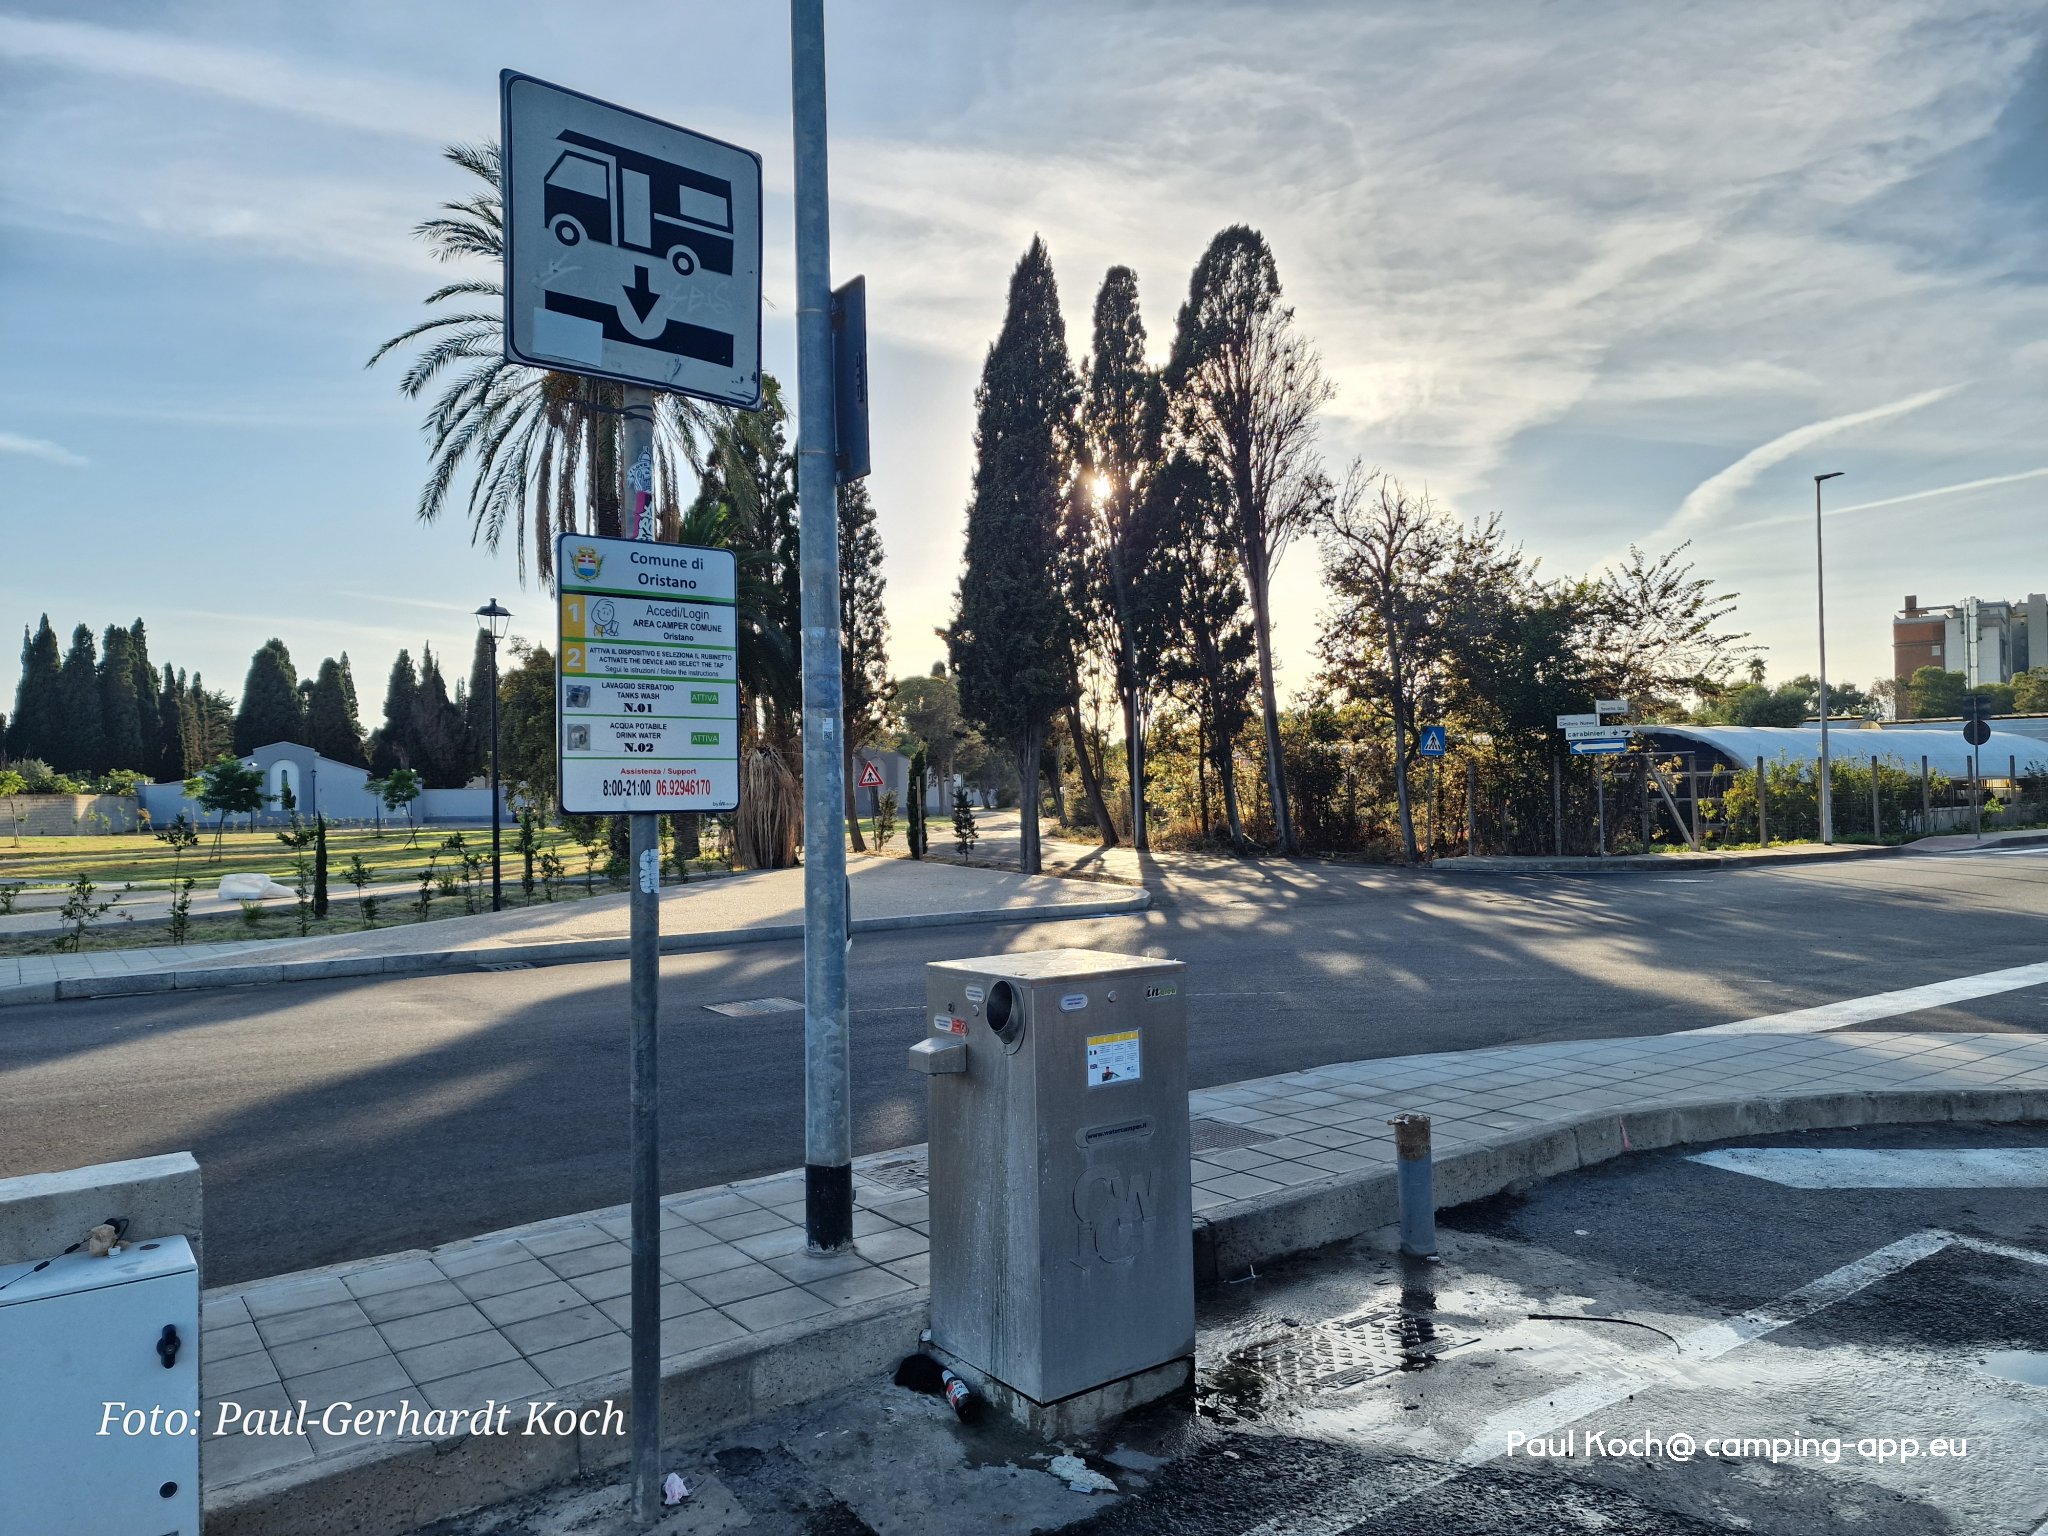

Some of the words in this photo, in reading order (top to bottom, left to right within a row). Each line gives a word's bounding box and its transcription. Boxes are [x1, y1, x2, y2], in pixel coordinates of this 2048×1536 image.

[630, 551, 687, 569] Comune
[692, 557, 704, 570] di
[638, 572, 697, 589] Oristano
[567, 603, 579, 623] 1
[646, 604, 710, 622] Accedi/Login
[633, 619, 655, 628] AREA
[656, 621, 688, 631] CAMPER
[690, 623, 722, 633] COMUNE
[663, 632, 694, 642] Oristano
[566, 647, 581, 668] 2
[589, 647, 611, 655] ATTIVA
[618, 649, 655, 657] DISPOSITIVO
[661, 651, 694, 659] SELEZIONA
[701, 653, 732, 661] RUBINETTO
[599, 656, 628, 664] ACTIVATE
[642, 658, 664, 666] DEVICE
[605, 664, 622, 674] Segui
[623, 665, 629, 673] le
[630, 666, 656, 674] istruzioni
[660, 667, 676, 675] follow
[678, 668, 687, 676] the
[687, 669, 719, 677] instructions
[601, 682, 636, 691] LAVAGGIO
[637, 683, 675, 691] SERBATOIO
[617, 691, 639, 699] TANKS
[640, 692, 660, 700] WASH
[691, 693, 719, 703] ATTIVA
[623, 702, 653, 713] N.01
[609, 722, 635, 730] ACQUA
[635, 722, 667, 730] POTABILE
[616, 731, 637, 739] DRINK
[691, 734, 719, 743] ATTIVA
[623, 742, 654, 753] N.02
[620, 767, 662, 775] Assistenza
[667, 768, 697, 777] Support
[603, 779, 651, 797] 8:00-21:00
[656, 779, 711, 796] 06.92946170
[947, 1003, 953, 1012] 2
